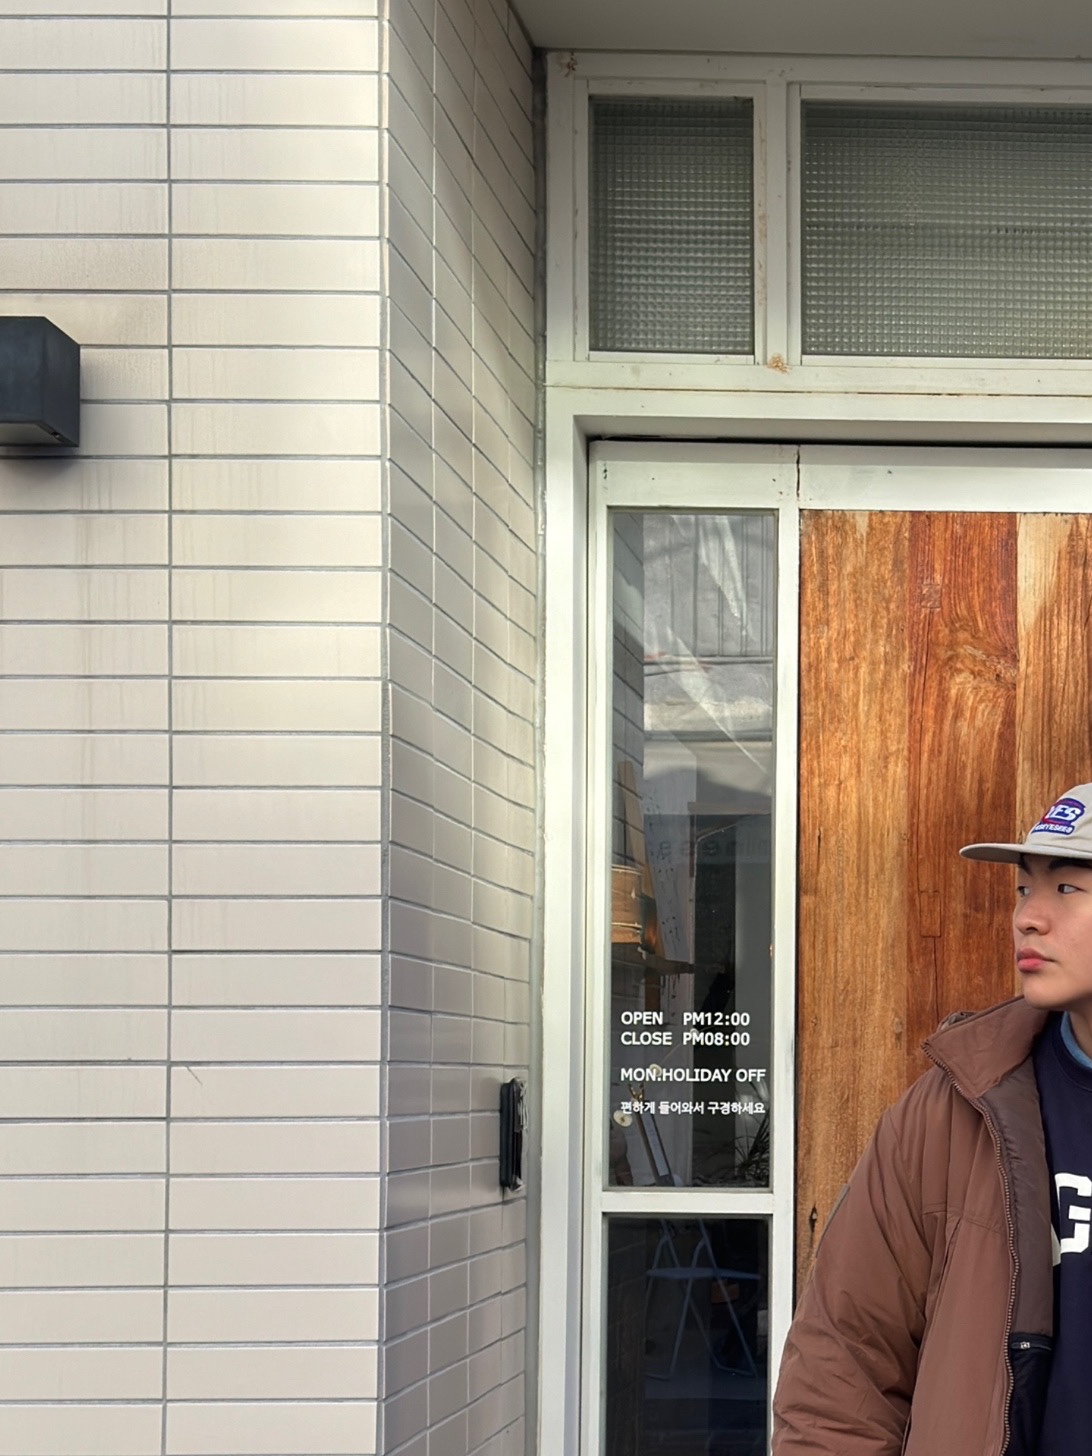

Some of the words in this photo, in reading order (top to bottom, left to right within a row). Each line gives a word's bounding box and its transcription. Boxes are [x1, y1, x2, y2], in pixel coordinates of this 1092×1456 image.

[620, 1011, 664, 1025] OPEN
[683, 1012, 751, 1026] PM12:00
[620, 1031, 673, 1046] CLOSE
[682, 1032, 751, 1046] PM08:00
[620, 1067, 732, 1082] MON.HOLIDAY
[735, 1069, 767, 1082] OFF
[620, 1101, 656, 1115] 편하게
[658, 1101, 705, 1115] 들어와서
[707, 1102, 766, 1115] 구경하세요
